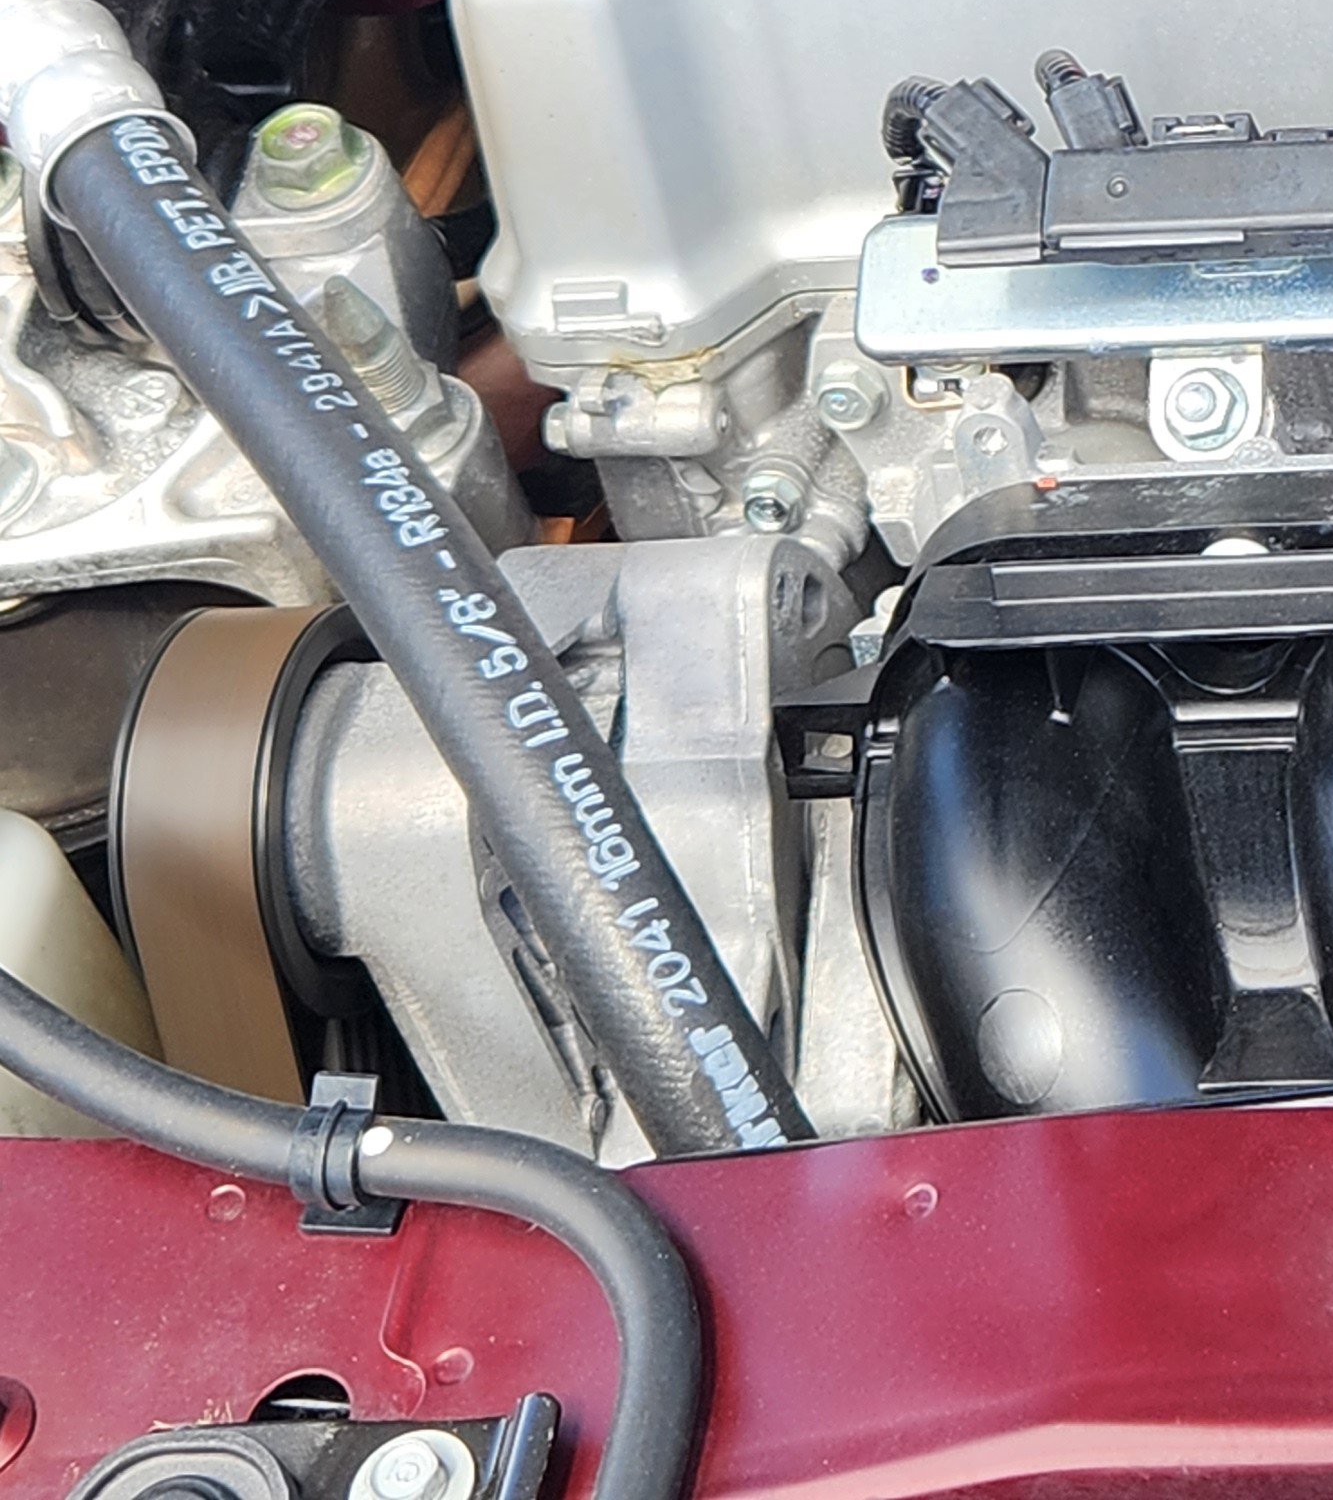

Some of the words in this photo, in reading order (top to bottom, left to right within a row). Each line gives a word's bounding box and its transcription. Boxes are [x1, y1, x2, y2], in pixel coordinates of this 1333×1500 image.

[362, 446, 450, 548] R134a
[437, 587, 530, 682] 5/8"
[505, 680, 571, 749] I.D.
[552, 751, 642, 892] 16mm
[613, 896, 709, 1019] 2041
